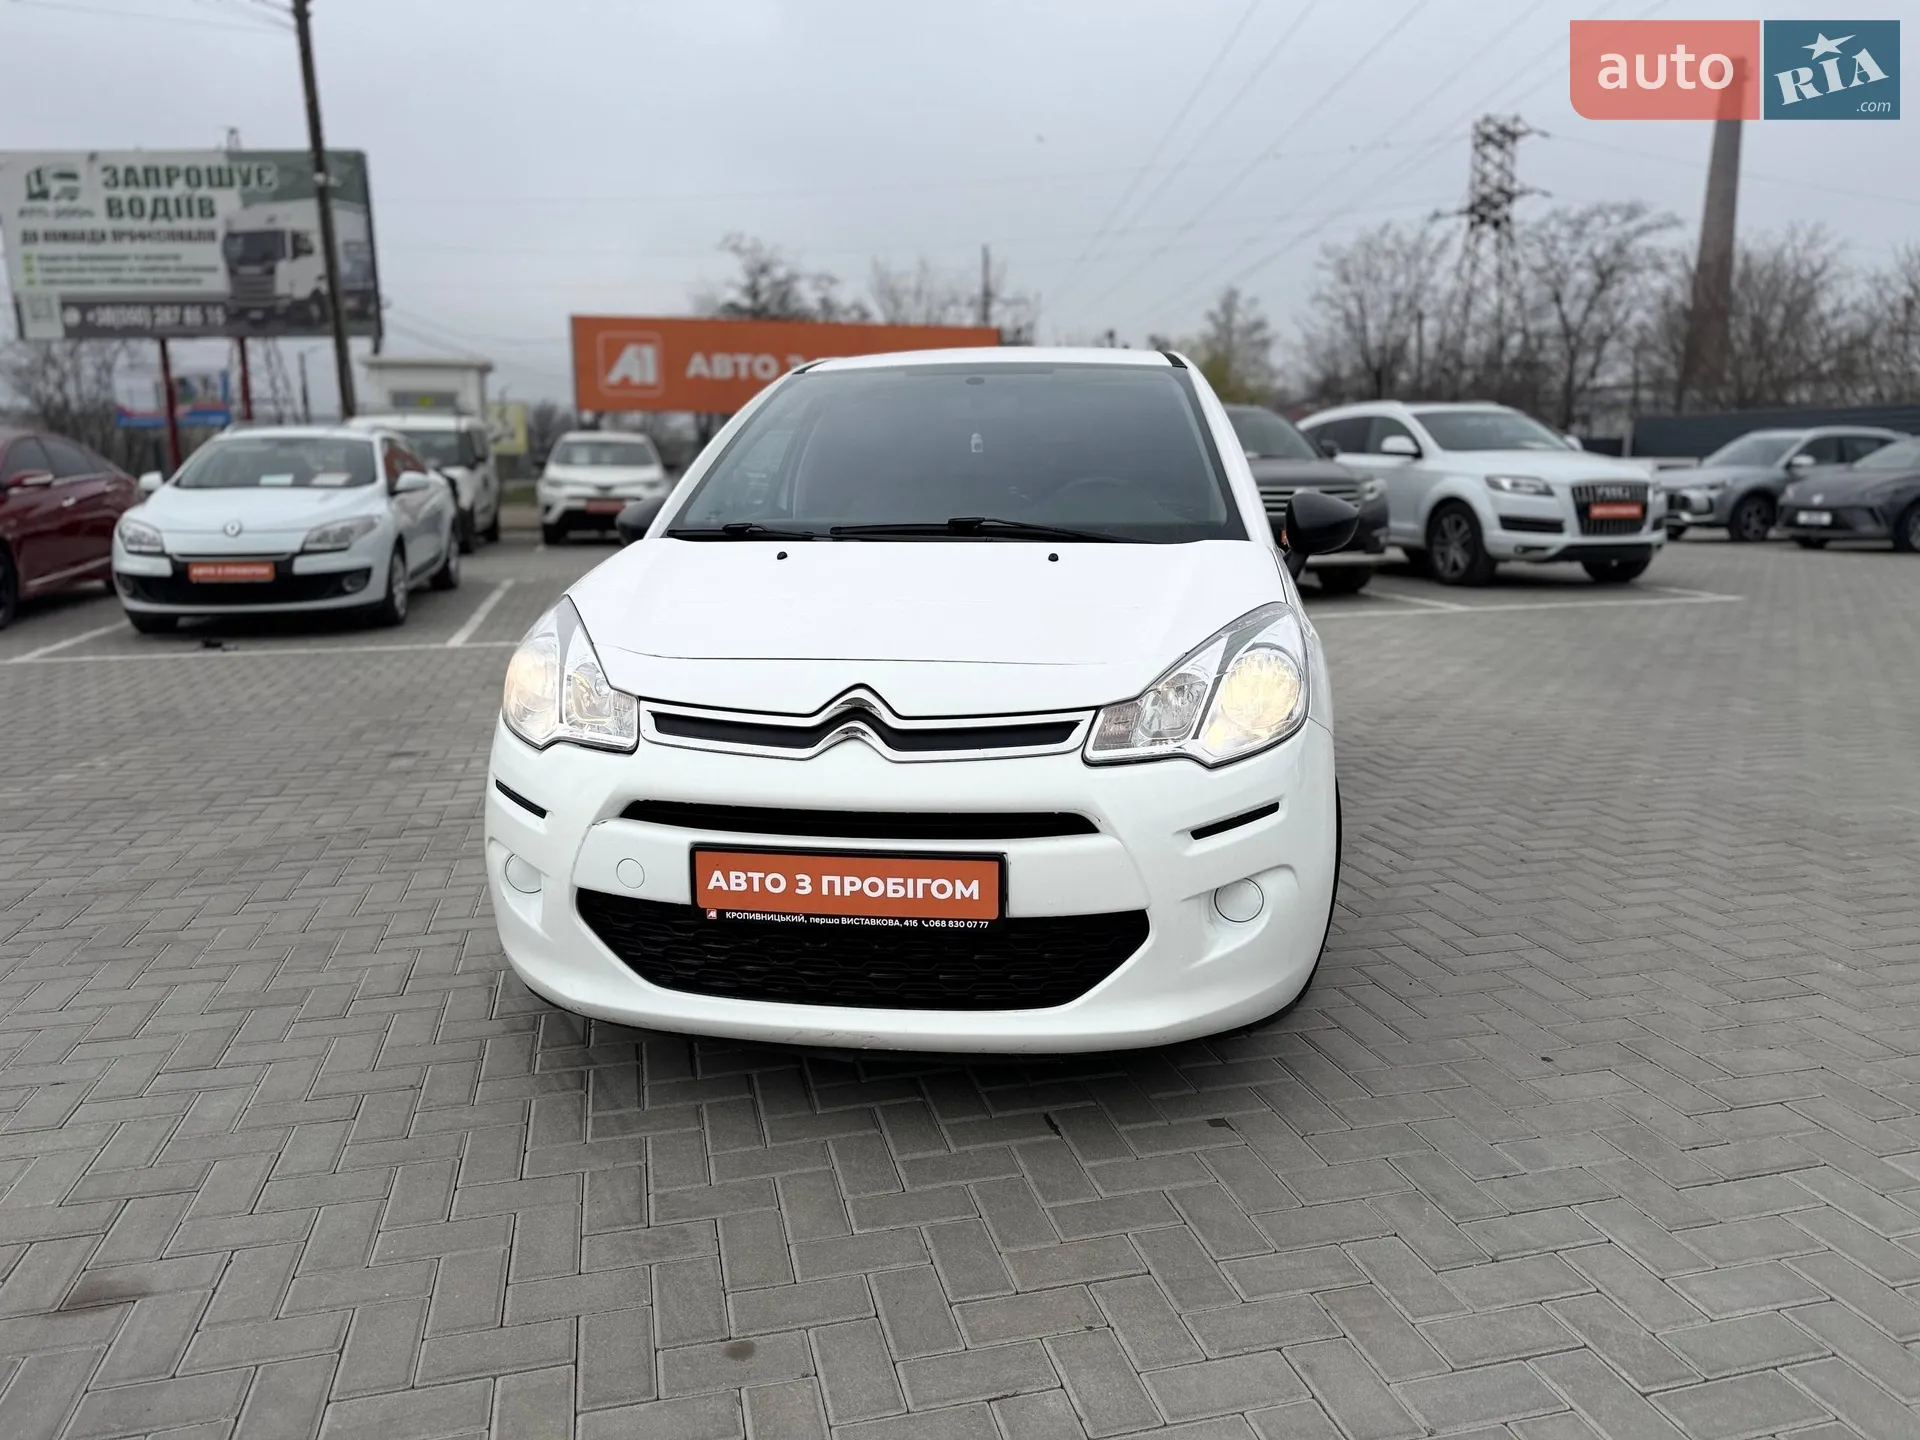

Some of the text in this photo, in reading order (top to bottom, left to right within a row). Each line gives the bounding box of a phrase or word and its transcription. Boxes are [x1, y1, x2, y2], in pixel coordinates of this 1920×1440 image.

[685, 351, 779, 380] АВТО
[707, 869, 787, 894] АВТО
[821, 875, 980, 900] ПРОБІГОМ
[725, 911, 807, 923] КРОПИВНИЦЬКИЙ,
[810, 916, 840, 924] перша
[841, 917, 902, 927] ВИСТАВКОВА,
[929, 919, 947, 928] 068
[948, 920, 965, 928] 830
[966, 920, 977, 929] 07
[979, 921, 989, 929] 77
